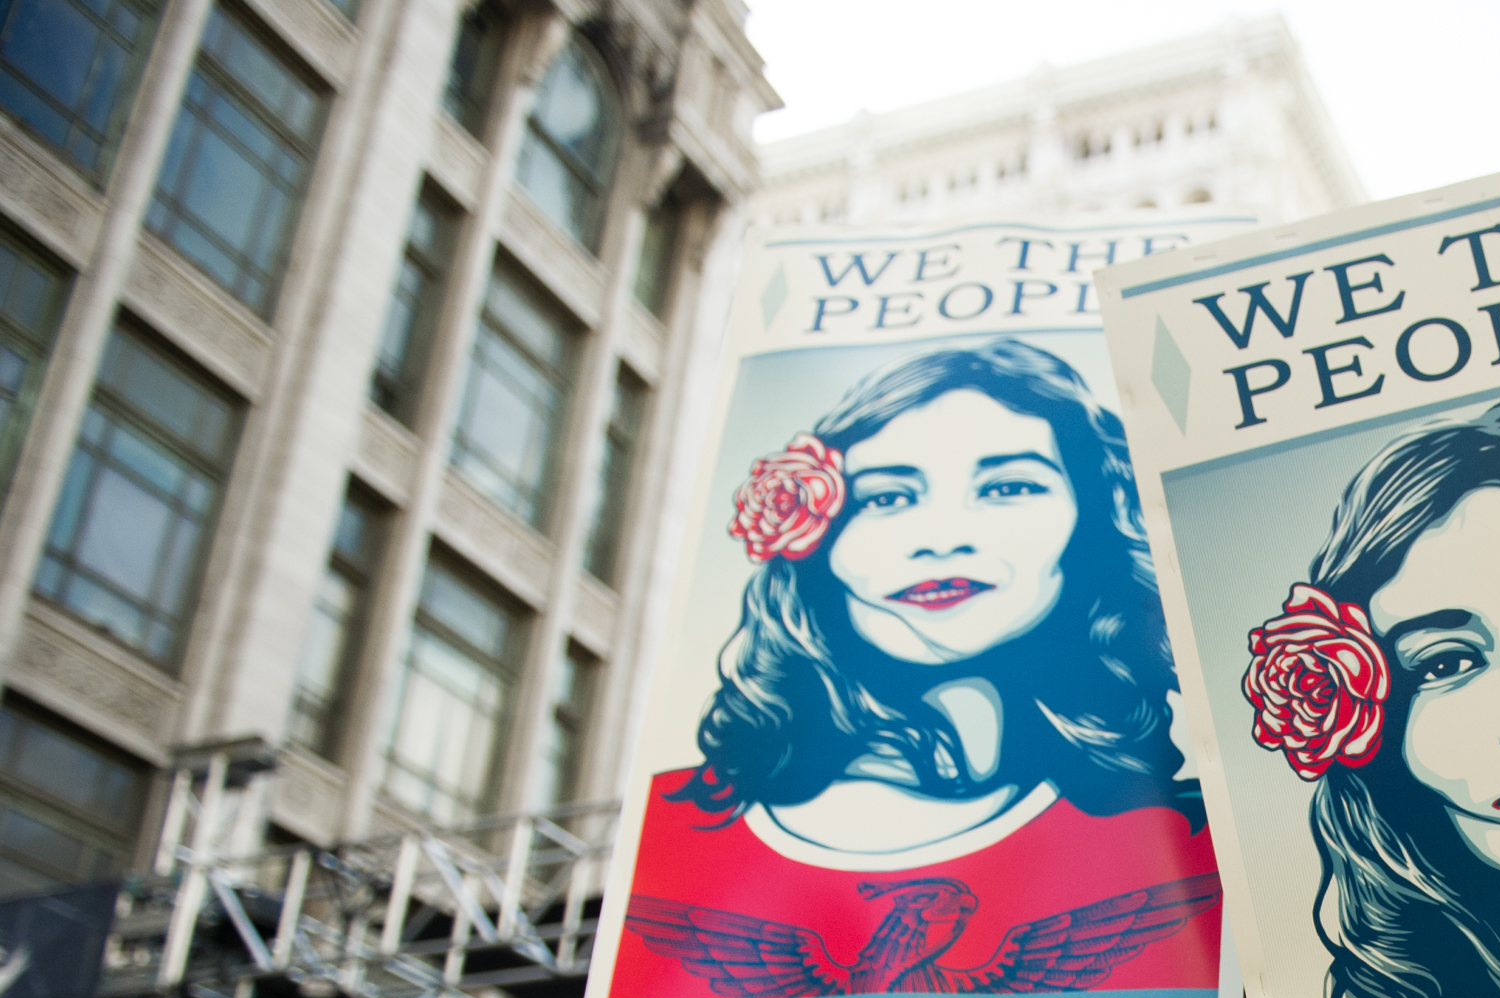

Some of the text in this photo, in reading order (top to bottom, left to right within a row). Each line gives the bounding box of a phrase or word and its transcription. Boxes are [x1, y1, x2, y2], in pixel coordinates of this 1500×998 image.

[812, 244, 964, 288] WE
[803, 281, 1102, 332] PEOPL
[1192, 252, 1407, 351] WE
